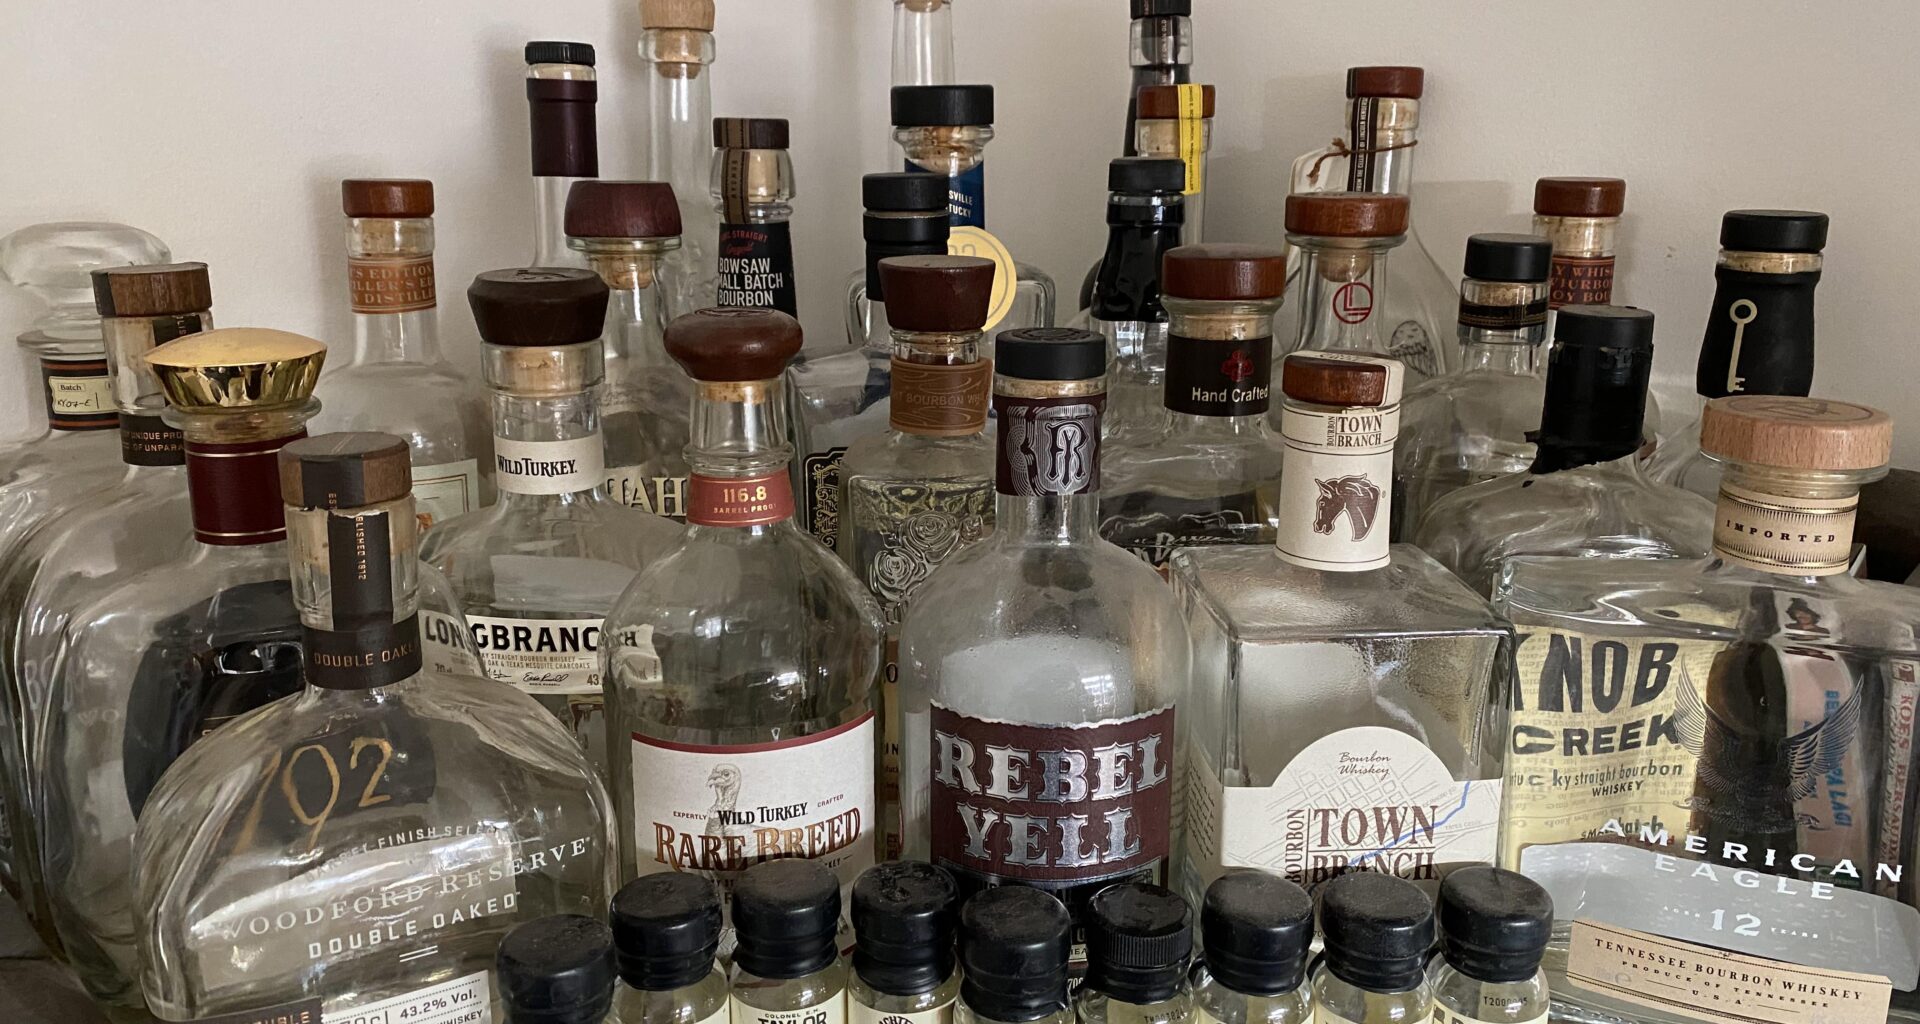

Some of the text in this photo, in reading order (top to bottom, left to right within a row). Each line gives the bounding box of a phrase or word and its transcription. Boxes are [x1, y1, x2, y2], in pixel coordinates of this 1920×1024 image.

[719, 257, 770, 274] BOWSAW
[744, 272, 784, 291] BATCH
[718, 290, 774, 307] BOURBON
[60, 384, 82, 392] Batch
[906, 393, 964, 406] BOURBON
[1192, 384, 1269, 403] Hand Crafted
[1338, 414, 1382, 433] TOWN
[1337, 432, 1382, 448] BRANCH
[497, 454, 523, 475] WILD
[723, 485, 768, 504] 116.8
[1726, 519, 1836, 543] IMPORTED
[313, 653, 375, 668] DOUBLE
[490, 653, 518, 661] STRAIGHT
[520, 655, 548, 663] BOURBON
[1512, 713, 1680, 757] CREEK
[934, 730, 1168, 806] REBEL
[1338, 750, 1392, 764] Bourbon
[1337, 764, 1391, 781] Whiskey
[1574, 766, 1617, 787] straight
[1619, 759, 1683, 780] bourbon
[1592, 780, 1645, 797] WHISKEY
[673, 793, 844, 826] EXPERTLY WILD TURKEY CRAFTED
[377, 825, 437, 848] FINISH
[956, 802, 1142, 869] YELL
[1313, 805, 1438, 848] TOWN
[652, 821, 748, 873] RARE
[753, 807, 862, 860] BREED
[1284, 809, 1305, 884] BOURBON
[1599, 818, 1903, 883] AMERICAN
[1311, 850, 1438, 884] BRANCH
[1653, 852, 1835, 901] EAGLE
[220, 836, 589, 940] WOODFORD RESERVE
[308, 892, 516, 960] DOUBLE OAKED
[1710, 908, 1762, 937] 12
[1770, 926, 1819, 940] YEARS
[1595, 938, 1864, 1001] TENNESSEE BOURBON WHISKEY
[1622, 959, 1693, 983] PRODUCE
[1704, 981, 1722, 989] OF
[1733, 986, 1830, 1009] TENNESSEE
[399, 998, 447, 1020] 43.2%
[451, 989, 478, 1005] Vol.
[764, 1012, 801, 1020] COLONEL
